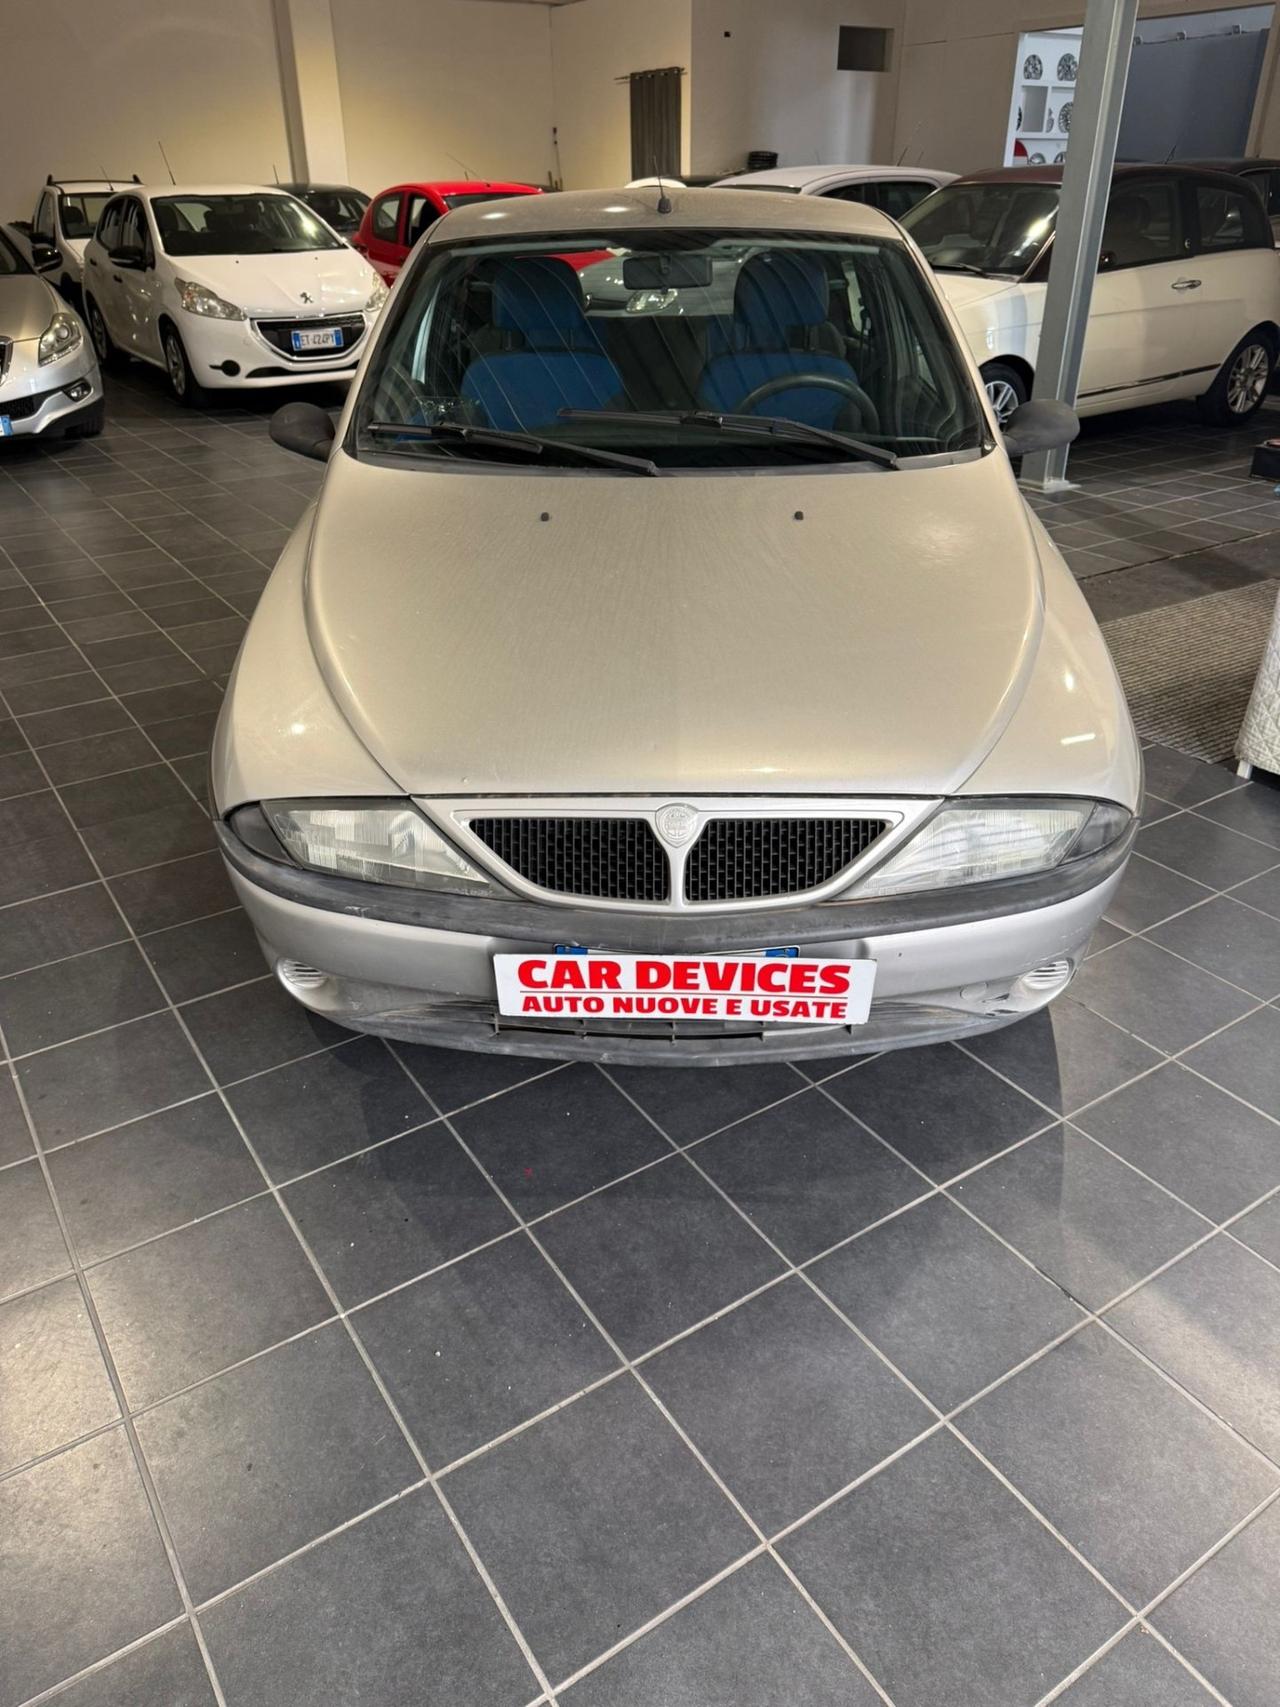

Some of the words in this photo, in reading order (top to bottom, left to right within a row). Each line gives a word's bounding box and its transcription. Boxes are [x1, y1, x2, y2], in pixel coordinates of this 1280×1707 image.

[517, 959, 622, 990] CAR
[635, 960, 851, 996] DEVICES
[521, 995, 606, 1013] AUTO
[612, 996, 718, 1016] NUOVE
[725, 998, 743, 1016] E
[750, 998, 848, 1020] USATE
